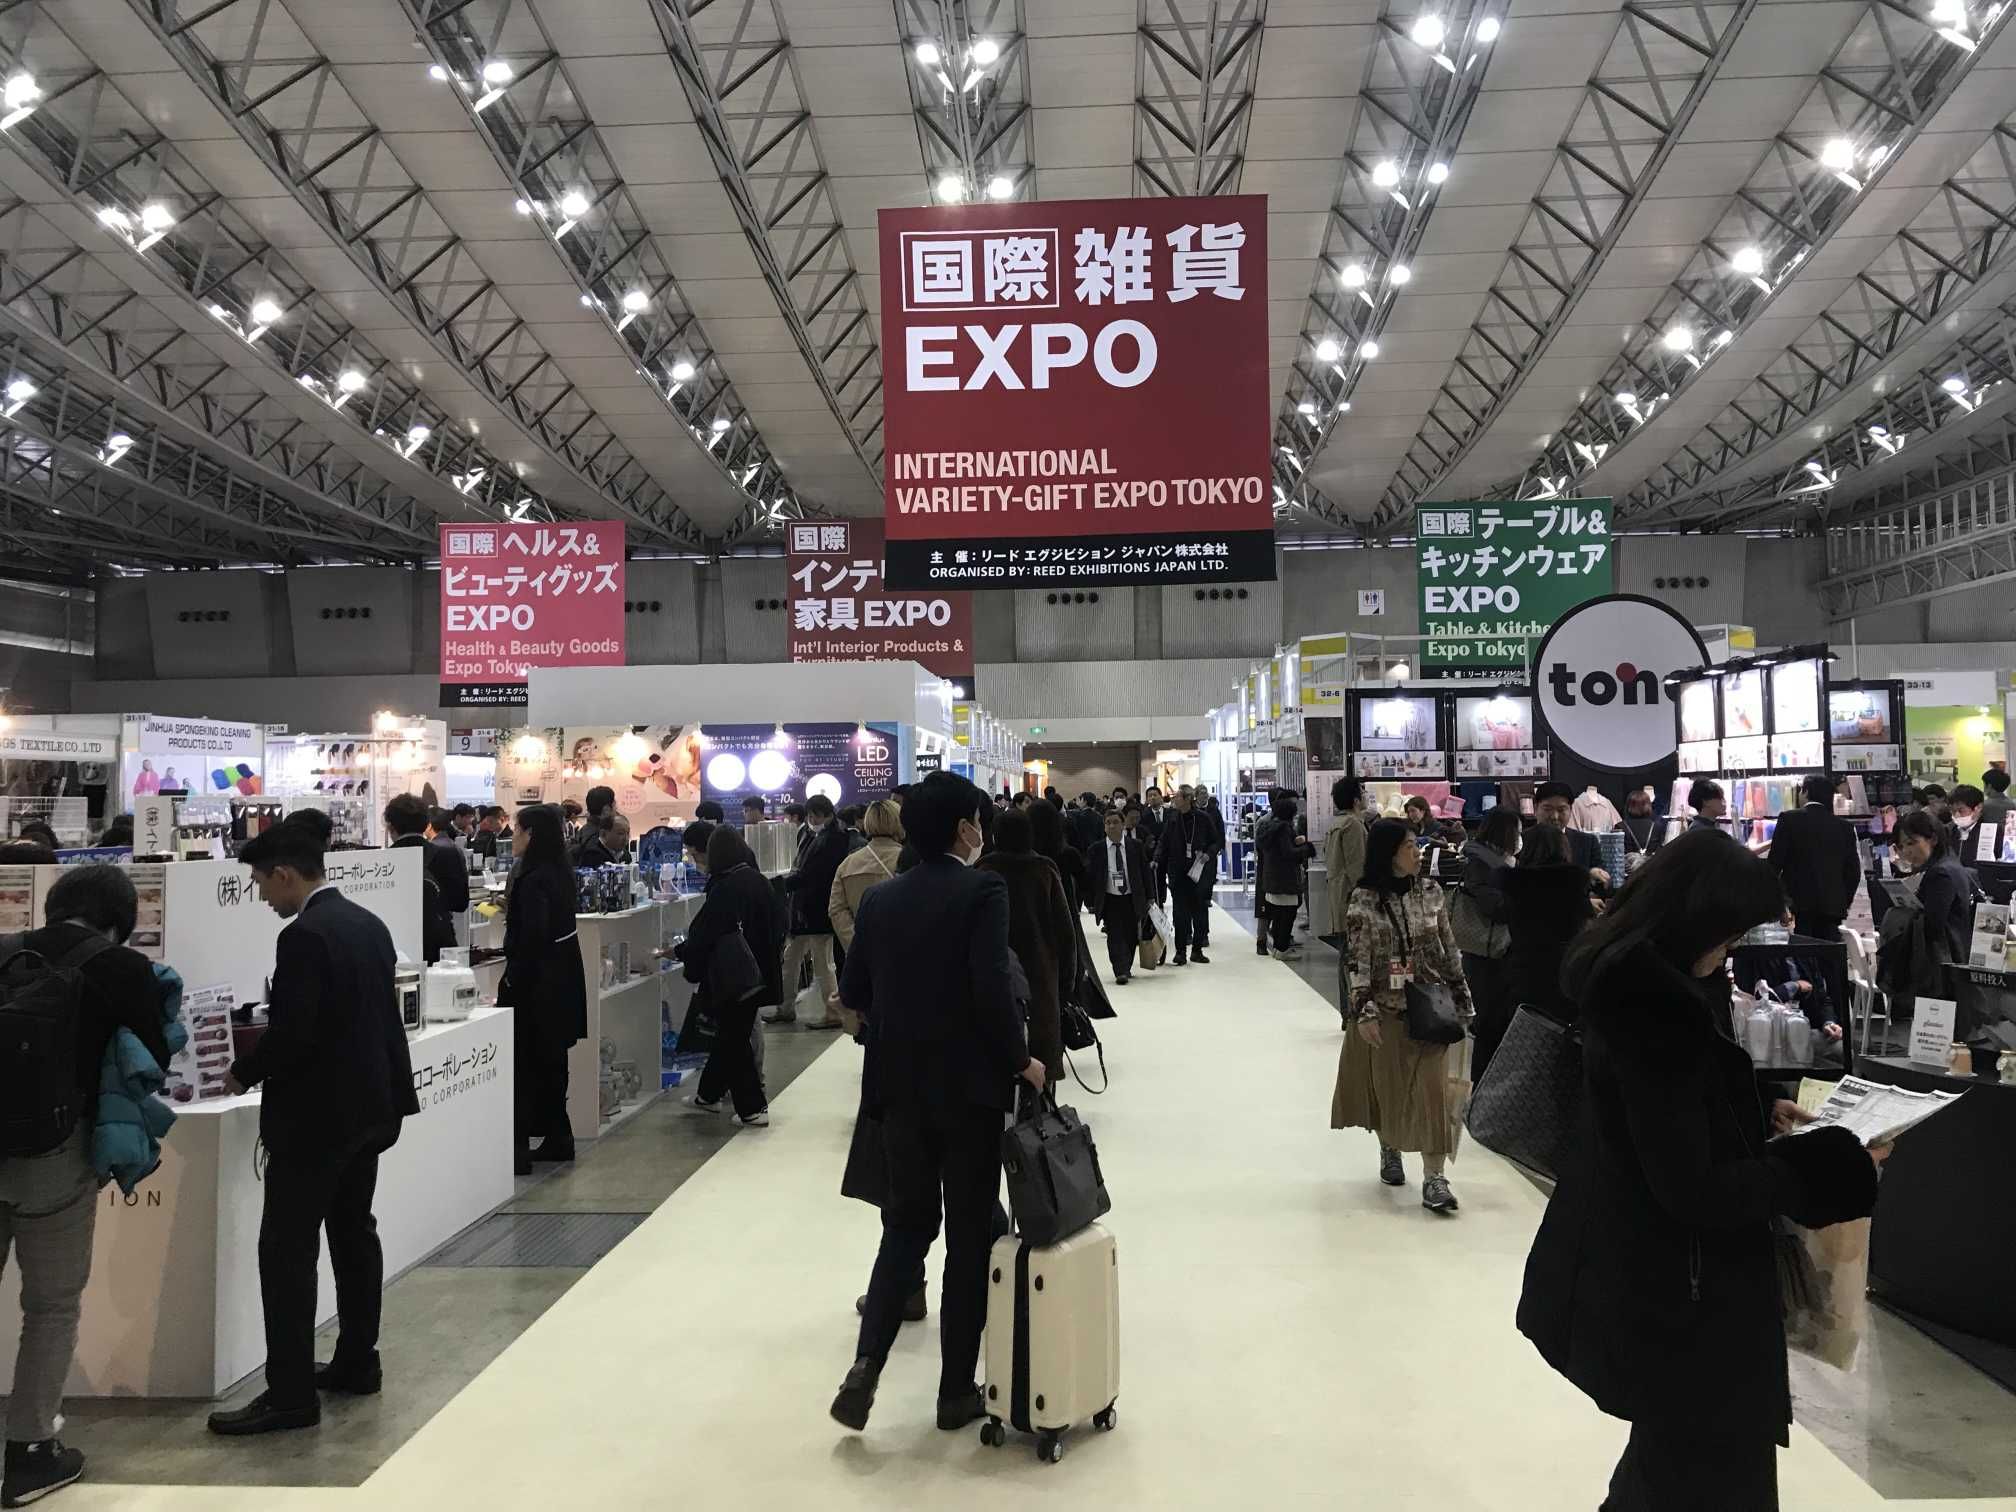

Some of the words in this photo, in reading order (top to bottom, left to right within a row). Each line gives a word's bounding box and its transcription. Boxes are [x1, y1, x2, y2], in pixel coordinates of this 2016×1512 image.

[912, 237, 1049, 303] 国際
[1074, 221, 1247, 306] 雑貨
[905, 319, 1158, 391] EXPO
[894, 448, 1117, 480] INTERNATIONAL
[895, 484, 1087, 514] VARIETY-GIFT
[1094, 479, 1167, 508] EXPO
[1172, 476, 1263, 506] TOKYO
[1422, 512, 1470, 535] 国際
[1478, 504, 1608, 540] テーブル&
[448, 533, 495, 555] 国際
[502, 528, 601, 557] ヘルス&
[793, 526, 846, 551] 国際
[930, 566, 1005, 579] ORGANISED
[1008, 566, 1031, 577] BY:
[1033, 565, 1066, 576] REED
[1070, 562, 1151, 576] EXHIBITIONS
[1154, 561, 1197, 573] JAPAN
[1200, 559, 1229, 571] LTD.
[1421, 543, 1607, 578] キッチンウェア
[445, 561, 620, 597] ビューティグッズ
[1425, 585, 1520, 613] EXPO
[447, 604, 535, 631] EXPO
[794, 597, 860, 631] 家具
[864, 599, 951, 627] EXPO
[1427, 621, 1474, 636] Table
[1478, 622, 1491, 635] &
[445, 640, 495, 656] Health
[500, 646, 507, 656] &
[510, 640, 565, 657] Beauty
[569, 637, 619, 654] Goods
[826, 640, 880, 653] Interior
[884, 639, 949, 652] Products
[953, 639, 964, 652] &
[1428, 641, 1470, 661] Expo
[445, 659, 483, 678] Expo
[145, 721, 173, 733] JINHUA
[220, 726, 251, 739] CLEANING
[168, 738, 206, 749] PRODUCTS
[461, 736, 471, 751] 9
[857, 746, 889, 762] LED
[854, 767, 893, 778] CEILING
[860, 778, 887, 787] LIGHT
[344, 880, 395, 894] CORPORATION
[433, 1067, 497, 1105] CORPORATION
